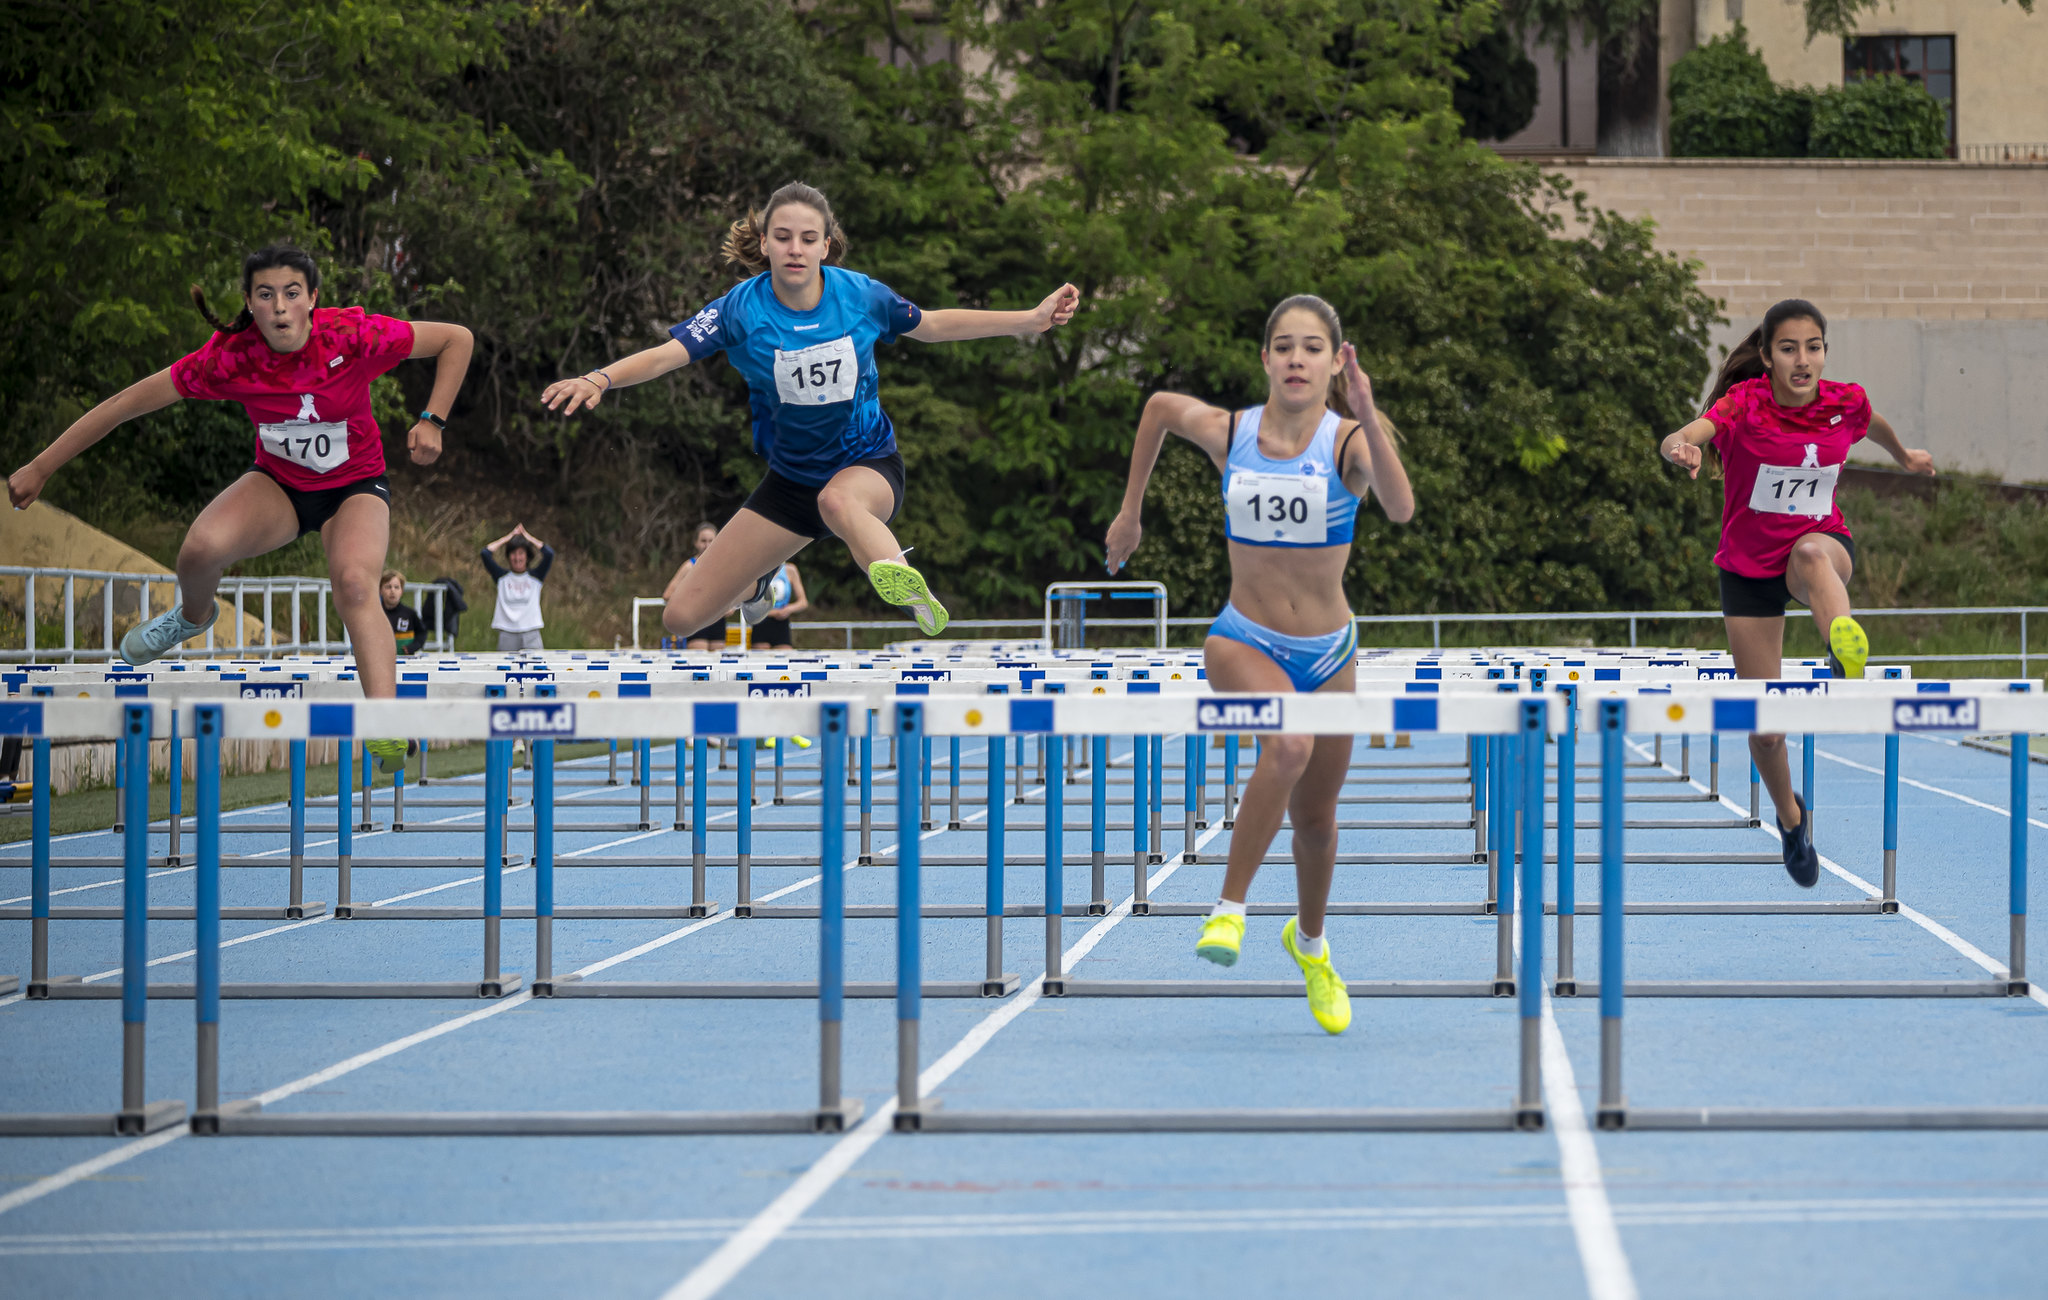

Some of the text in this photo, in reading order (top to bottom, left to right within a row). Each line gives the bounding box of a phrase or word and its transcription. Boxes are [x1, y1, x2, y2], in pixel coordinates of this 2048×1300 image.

[791, 359, 842, 389] 157
[278, 434, 331, 459] 170
[1772, 478, 1819, 499] 171
[1247, 494, 1308, 524] 130
[492, 703, 573, 732] e.m.d
[1199, 698, 1280, 726] e.m.d
[1896, 699, 1977, 726] e.m.d
